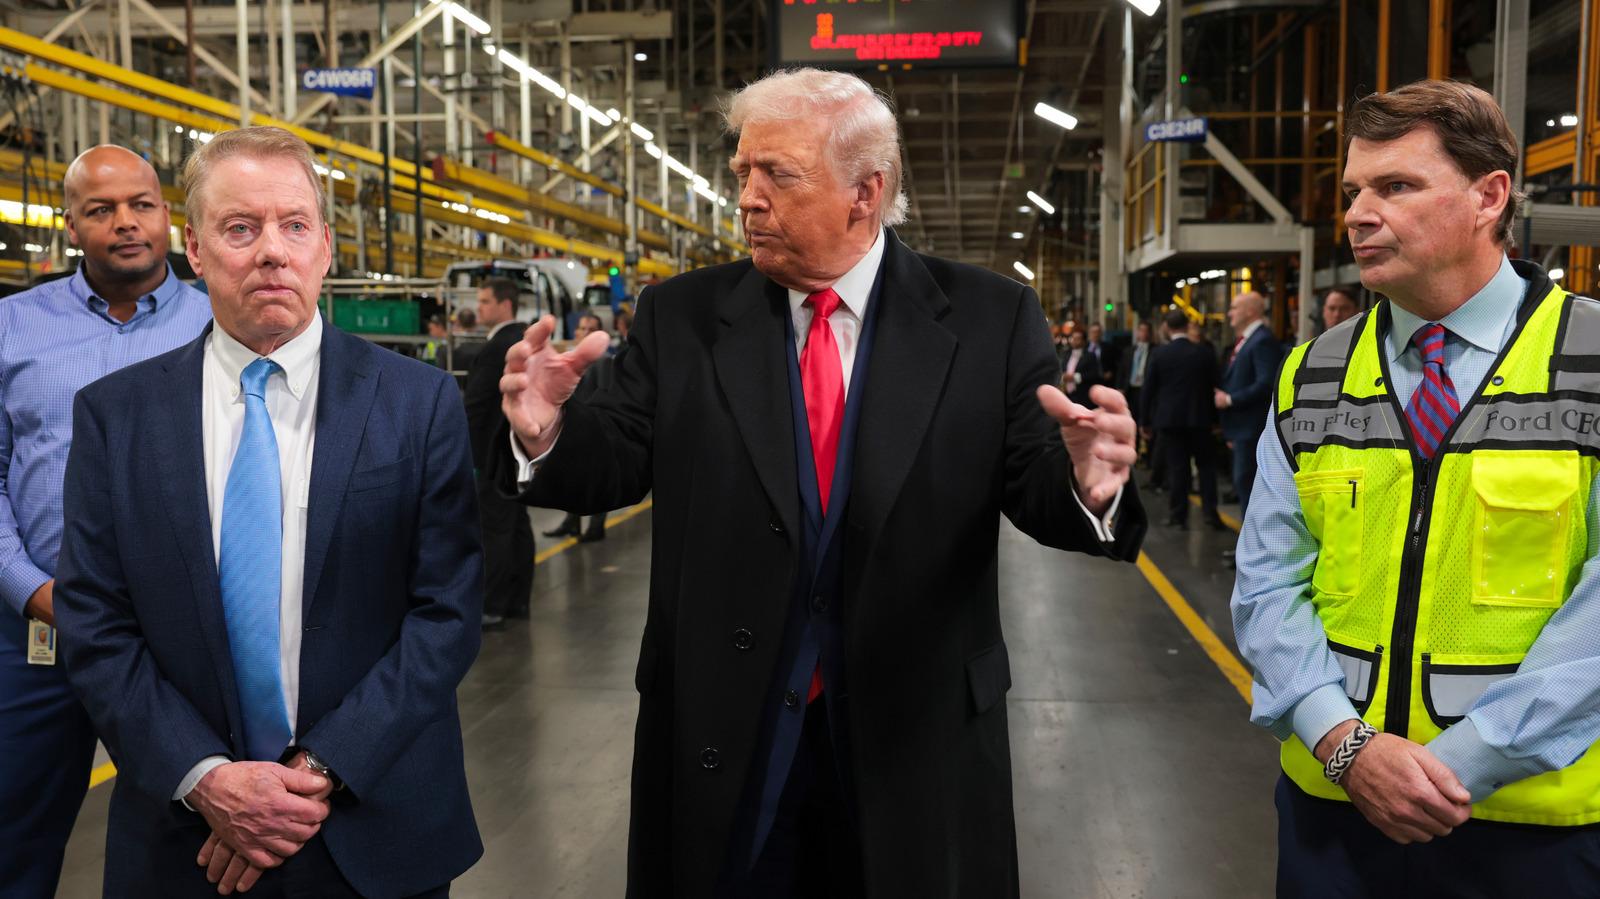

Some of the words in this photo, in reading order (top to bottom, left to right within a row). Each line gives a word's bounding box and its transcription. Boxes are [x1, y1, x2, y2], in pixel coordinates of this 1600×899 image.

[303, 70, 374, 89] C4W06R
[1291, 417, 1316, 432] im
[1322, 411, 1372, 432] Frley
[1484, 410, 1552, 432] Ford
